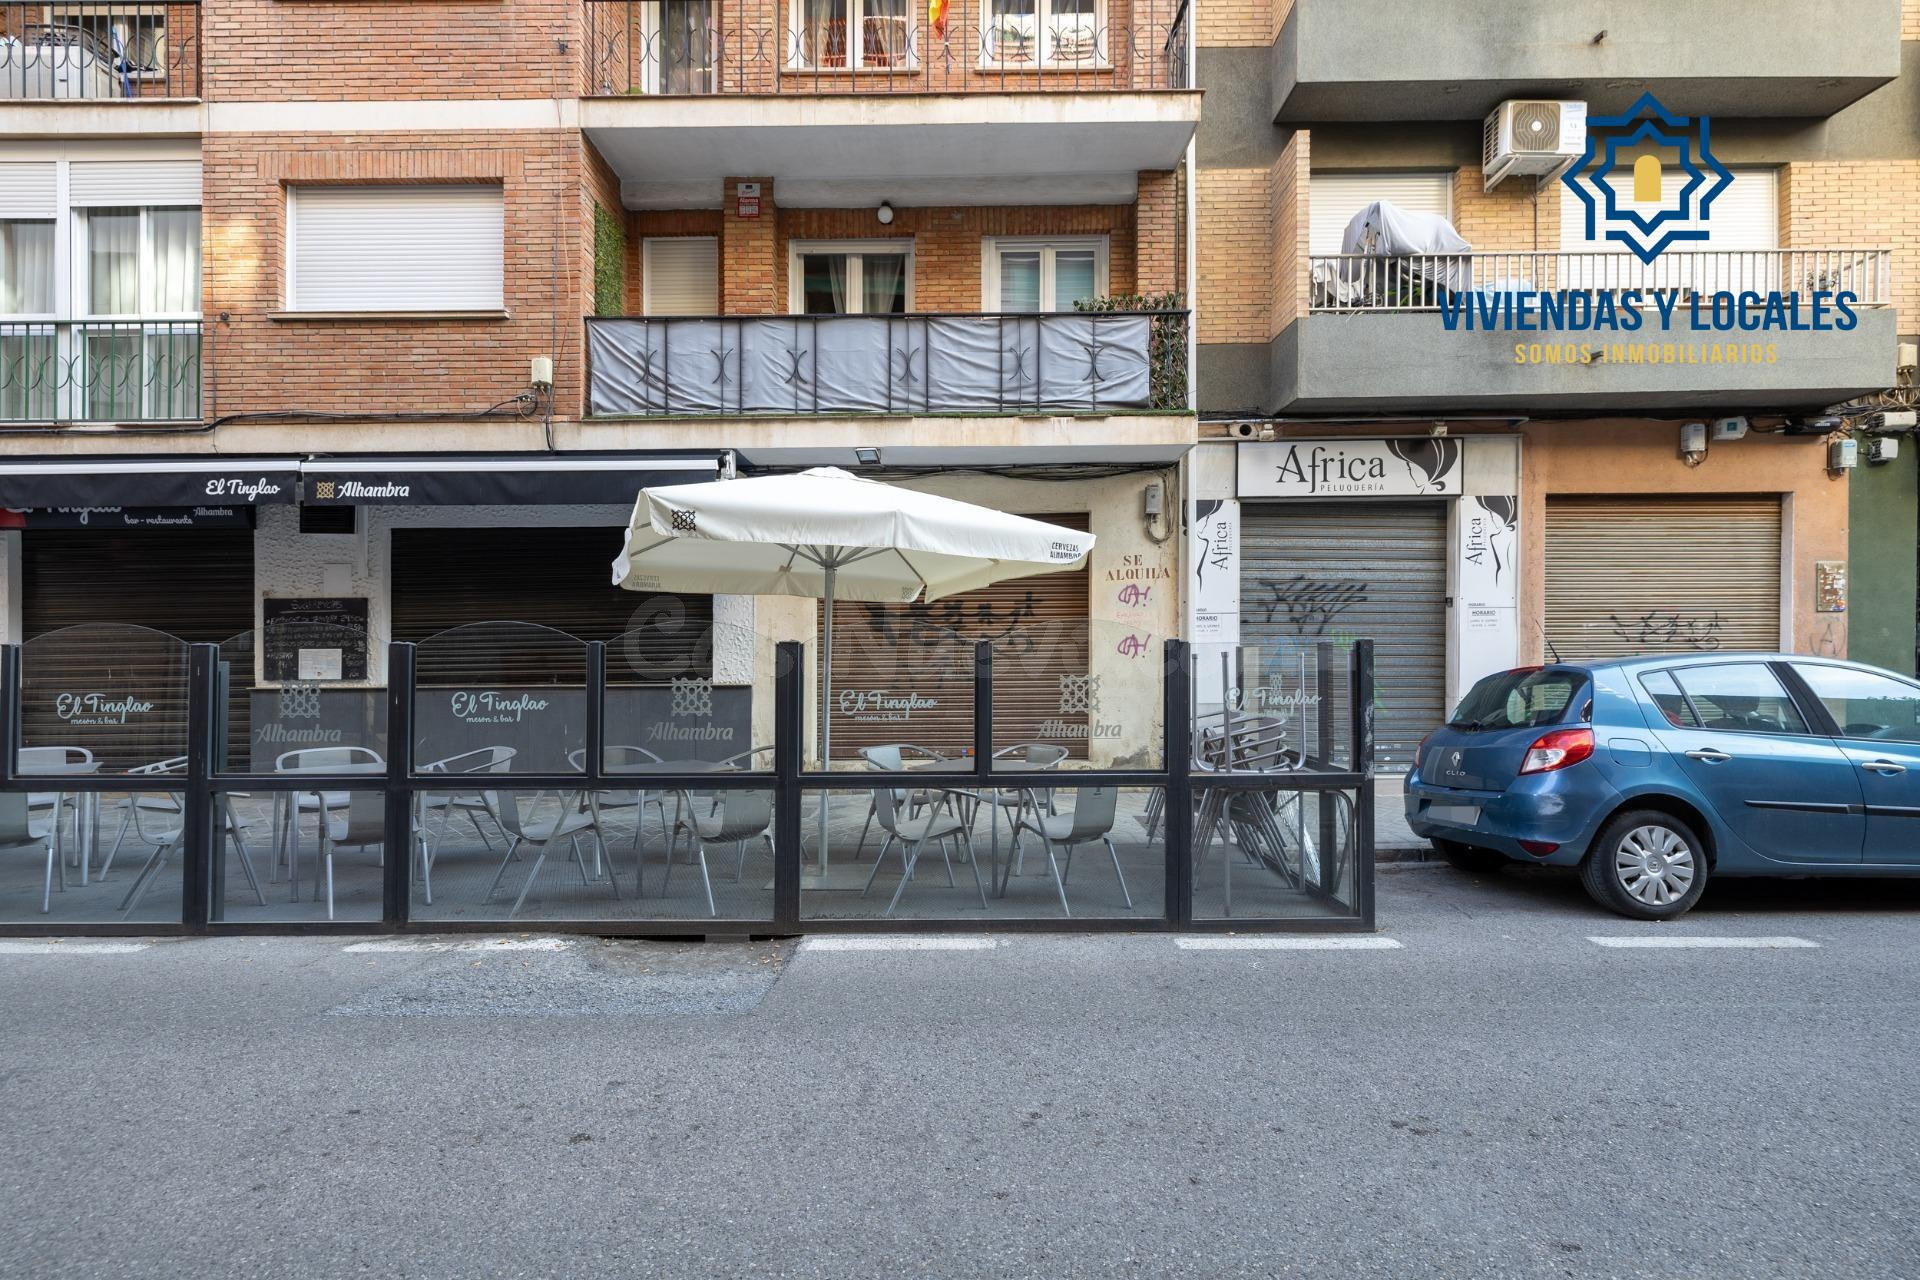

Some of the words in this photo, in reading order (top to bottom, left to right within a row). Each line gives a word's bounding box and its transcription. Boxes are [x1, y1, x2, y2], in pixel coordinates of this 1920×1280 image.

[1275, 444, 1387, 494] Africa
[205, 478, 226, 496] El
[226, 478, 281, 501] Tinglao
[336, 481, 410, 499] Alhambra
[124, 515, 139, 524] bar
[193, 507, 233, 516] Alhambra
[1051, 542, 1079, 552] CERVEZAS
[1210, 522, 1233, 570] Africa
[1465, 517, 1487, 566] Africa
[1123, 554, 1143, 566] SE
[1105, 567, 1170, 581] ALQUILA
[56, 693, 82, 719] El
[84, 693, 154, 724] Tinglao
[451, 692, 478, 717] El
[479, 691, 549, 722] Tinglao
[839, 689, 866, 715] El
[867, 689, 938, 720] Tinglao
[255, 723, 342, 743] Alhambra
[646, 722, 734, 741] Alhambra
[1035, 719, 1122, 741] Alhambra
